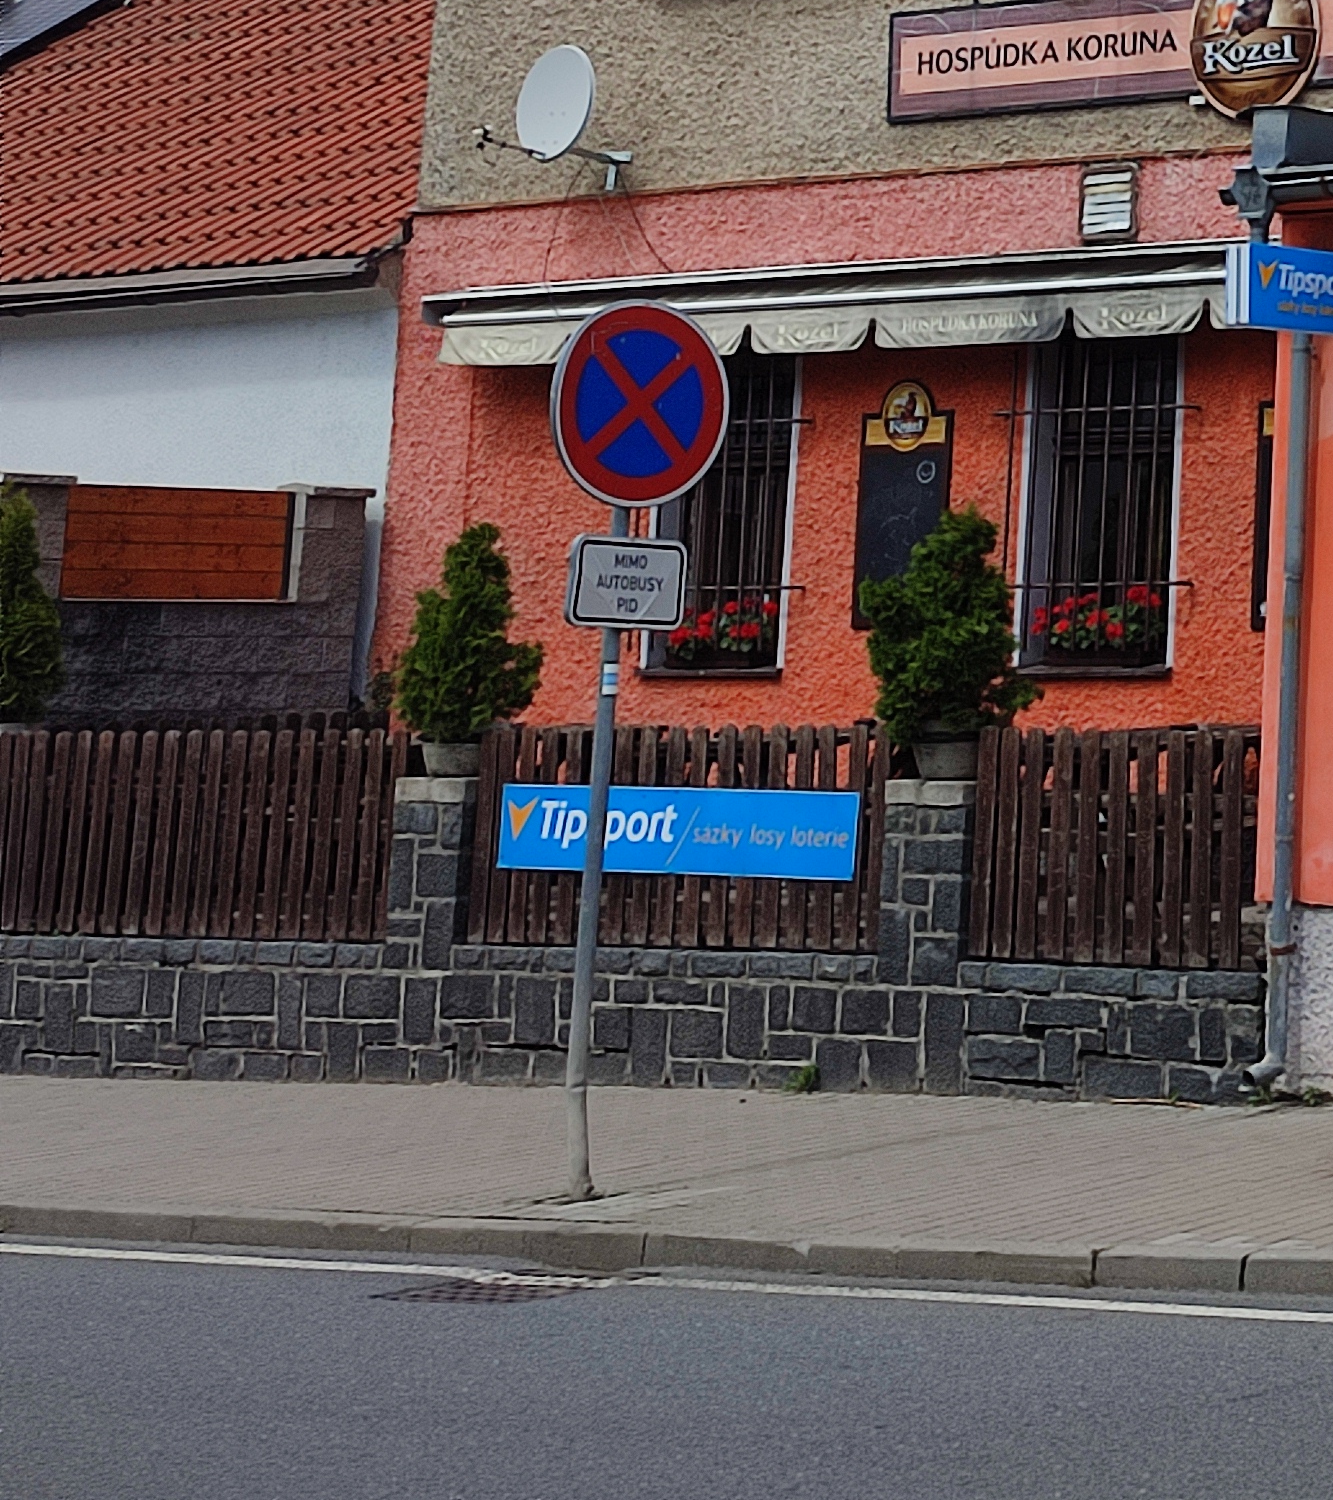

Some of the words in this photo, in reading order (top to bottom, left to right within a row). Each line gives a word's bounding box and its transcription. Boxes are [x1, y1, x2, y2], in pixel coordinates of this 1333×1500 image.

[1066, 29, 1178, 62] KORUNA
[1203, 34, 1299, 74] Kozel
[1100, 304, 1166, 330] Kozel
[614, 553, 648, 570] MIMO
[596, 574, 664, 592] AUTOBUSY
[616, 597, 639, 614] PID
[541, 799, 678, 850] Tipport
[692, 823, 743, 849] sázky
[750, 823, 786, 850] losy
[790, 825, 850, 849] loterie
